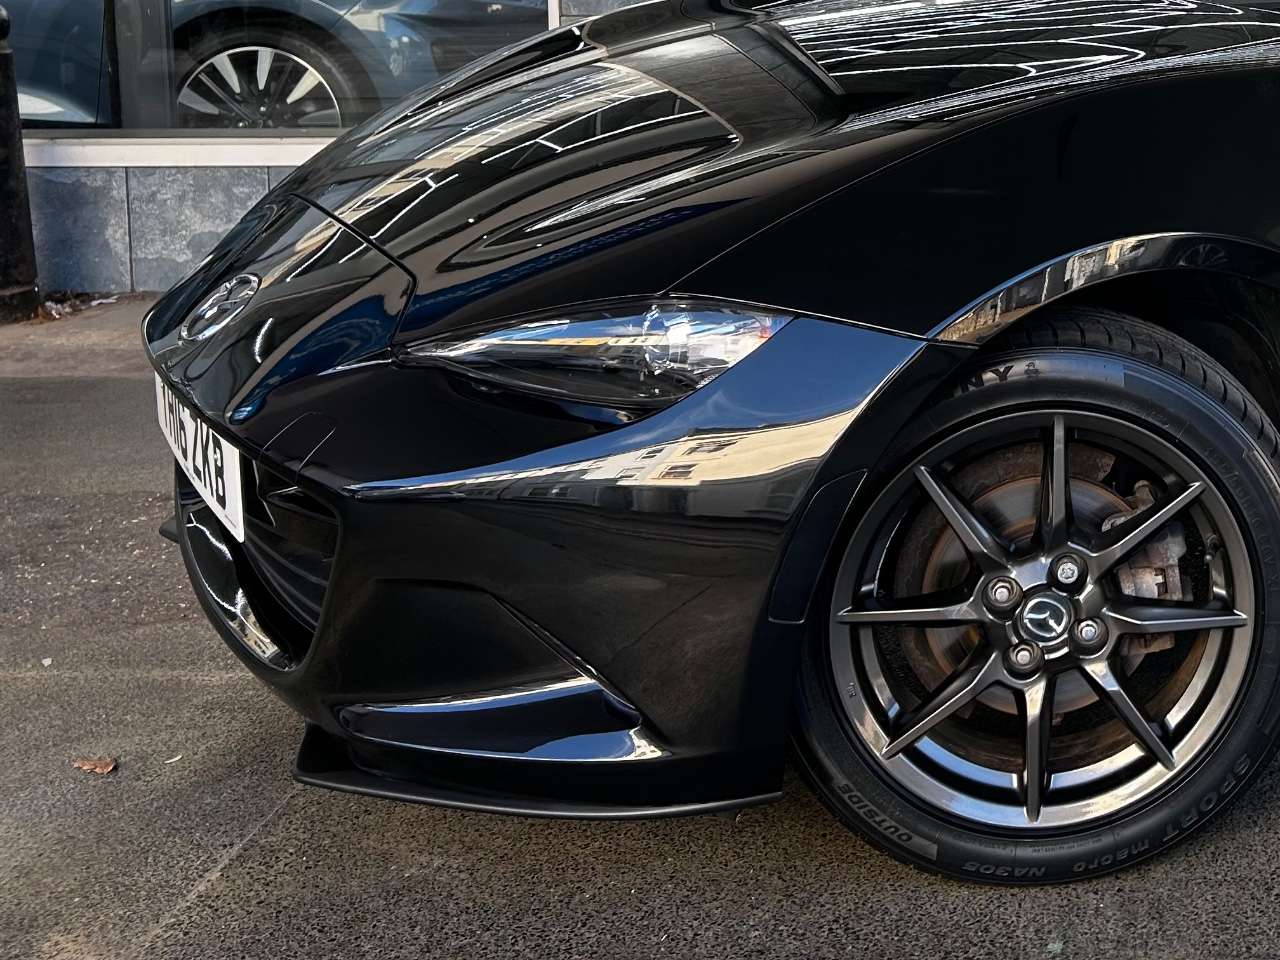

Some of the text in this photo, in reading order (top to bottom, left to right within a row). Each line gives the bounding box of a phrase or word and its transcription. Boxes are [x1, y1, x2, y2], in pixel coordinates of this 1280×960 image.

[838, 783, 913, 843] OUTSIDE
[962, 753, 1250, 878] SPORT macro NA305
